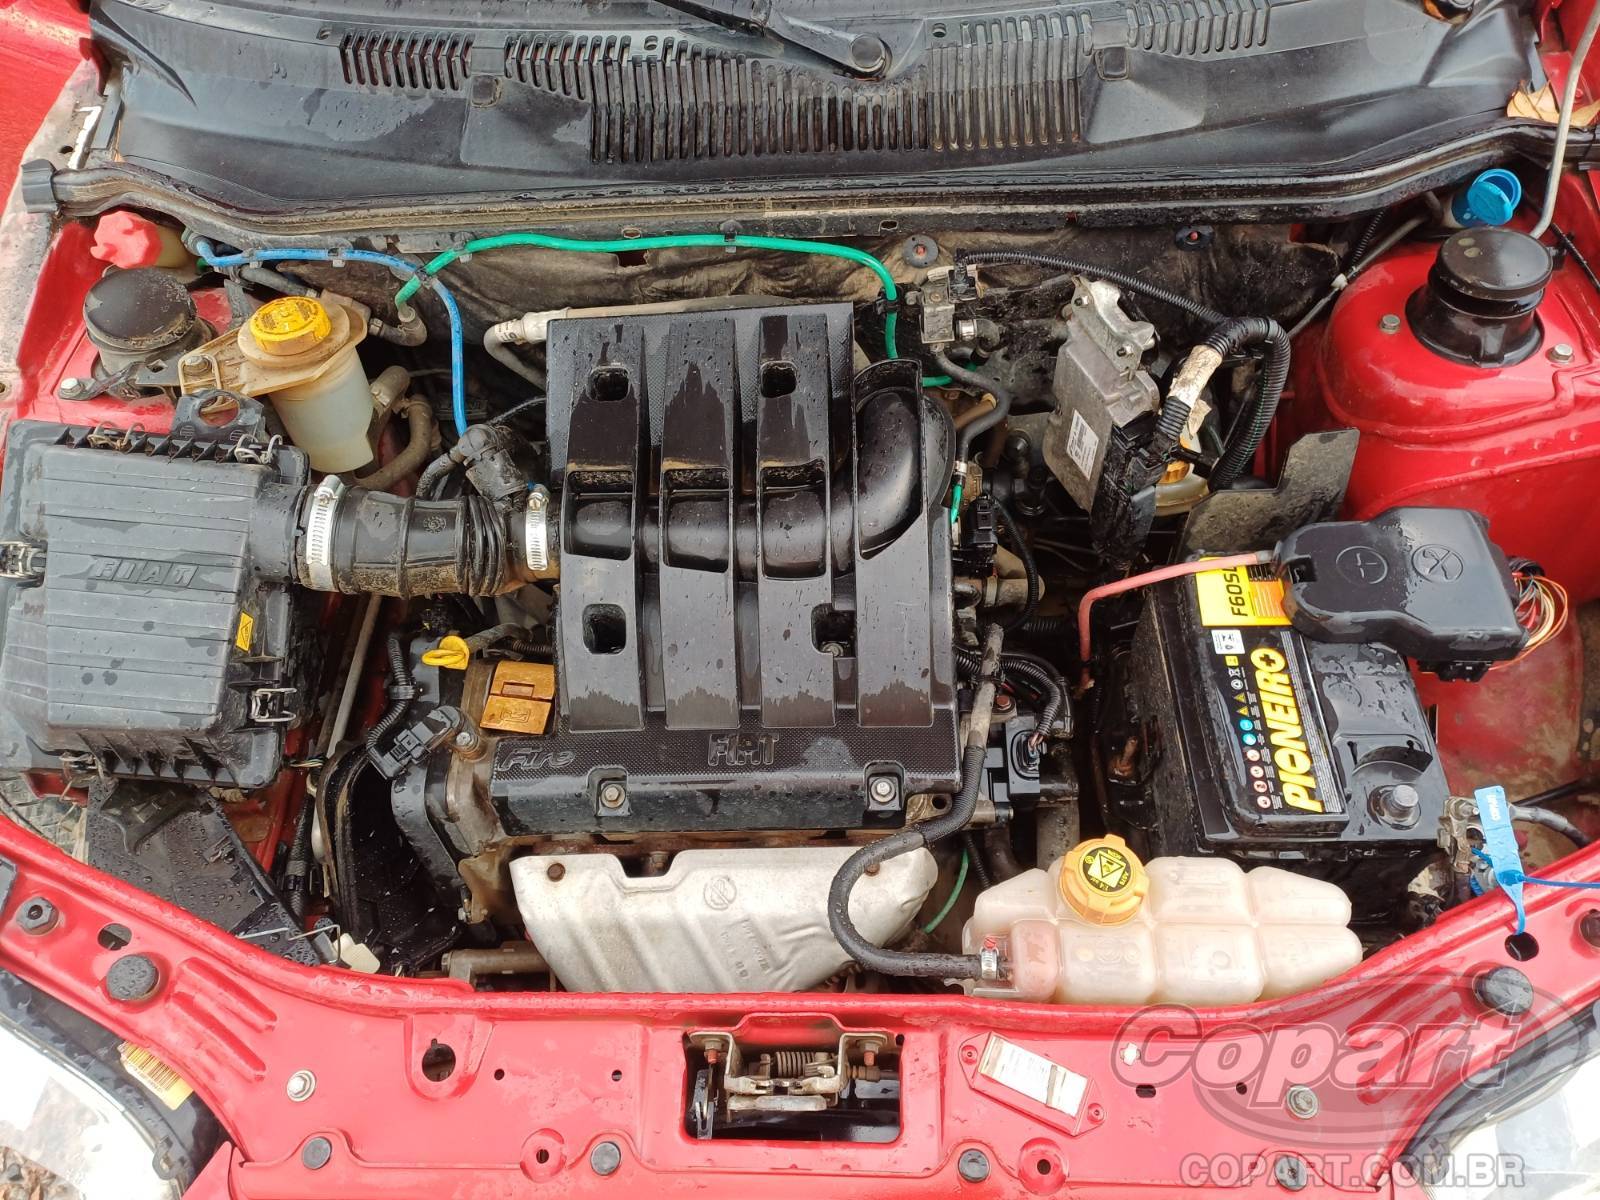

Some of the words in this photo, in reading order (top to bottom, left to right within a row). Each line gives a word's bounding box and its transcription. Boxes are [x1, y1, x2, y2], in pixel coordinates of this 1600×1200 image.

[96, 558, 198, 587] FIAT
[1250, 648, 1324, 813] PIONEIRO
[498, 747, 577, 771] Fire
[708, 732, 780, 766] FIAT
